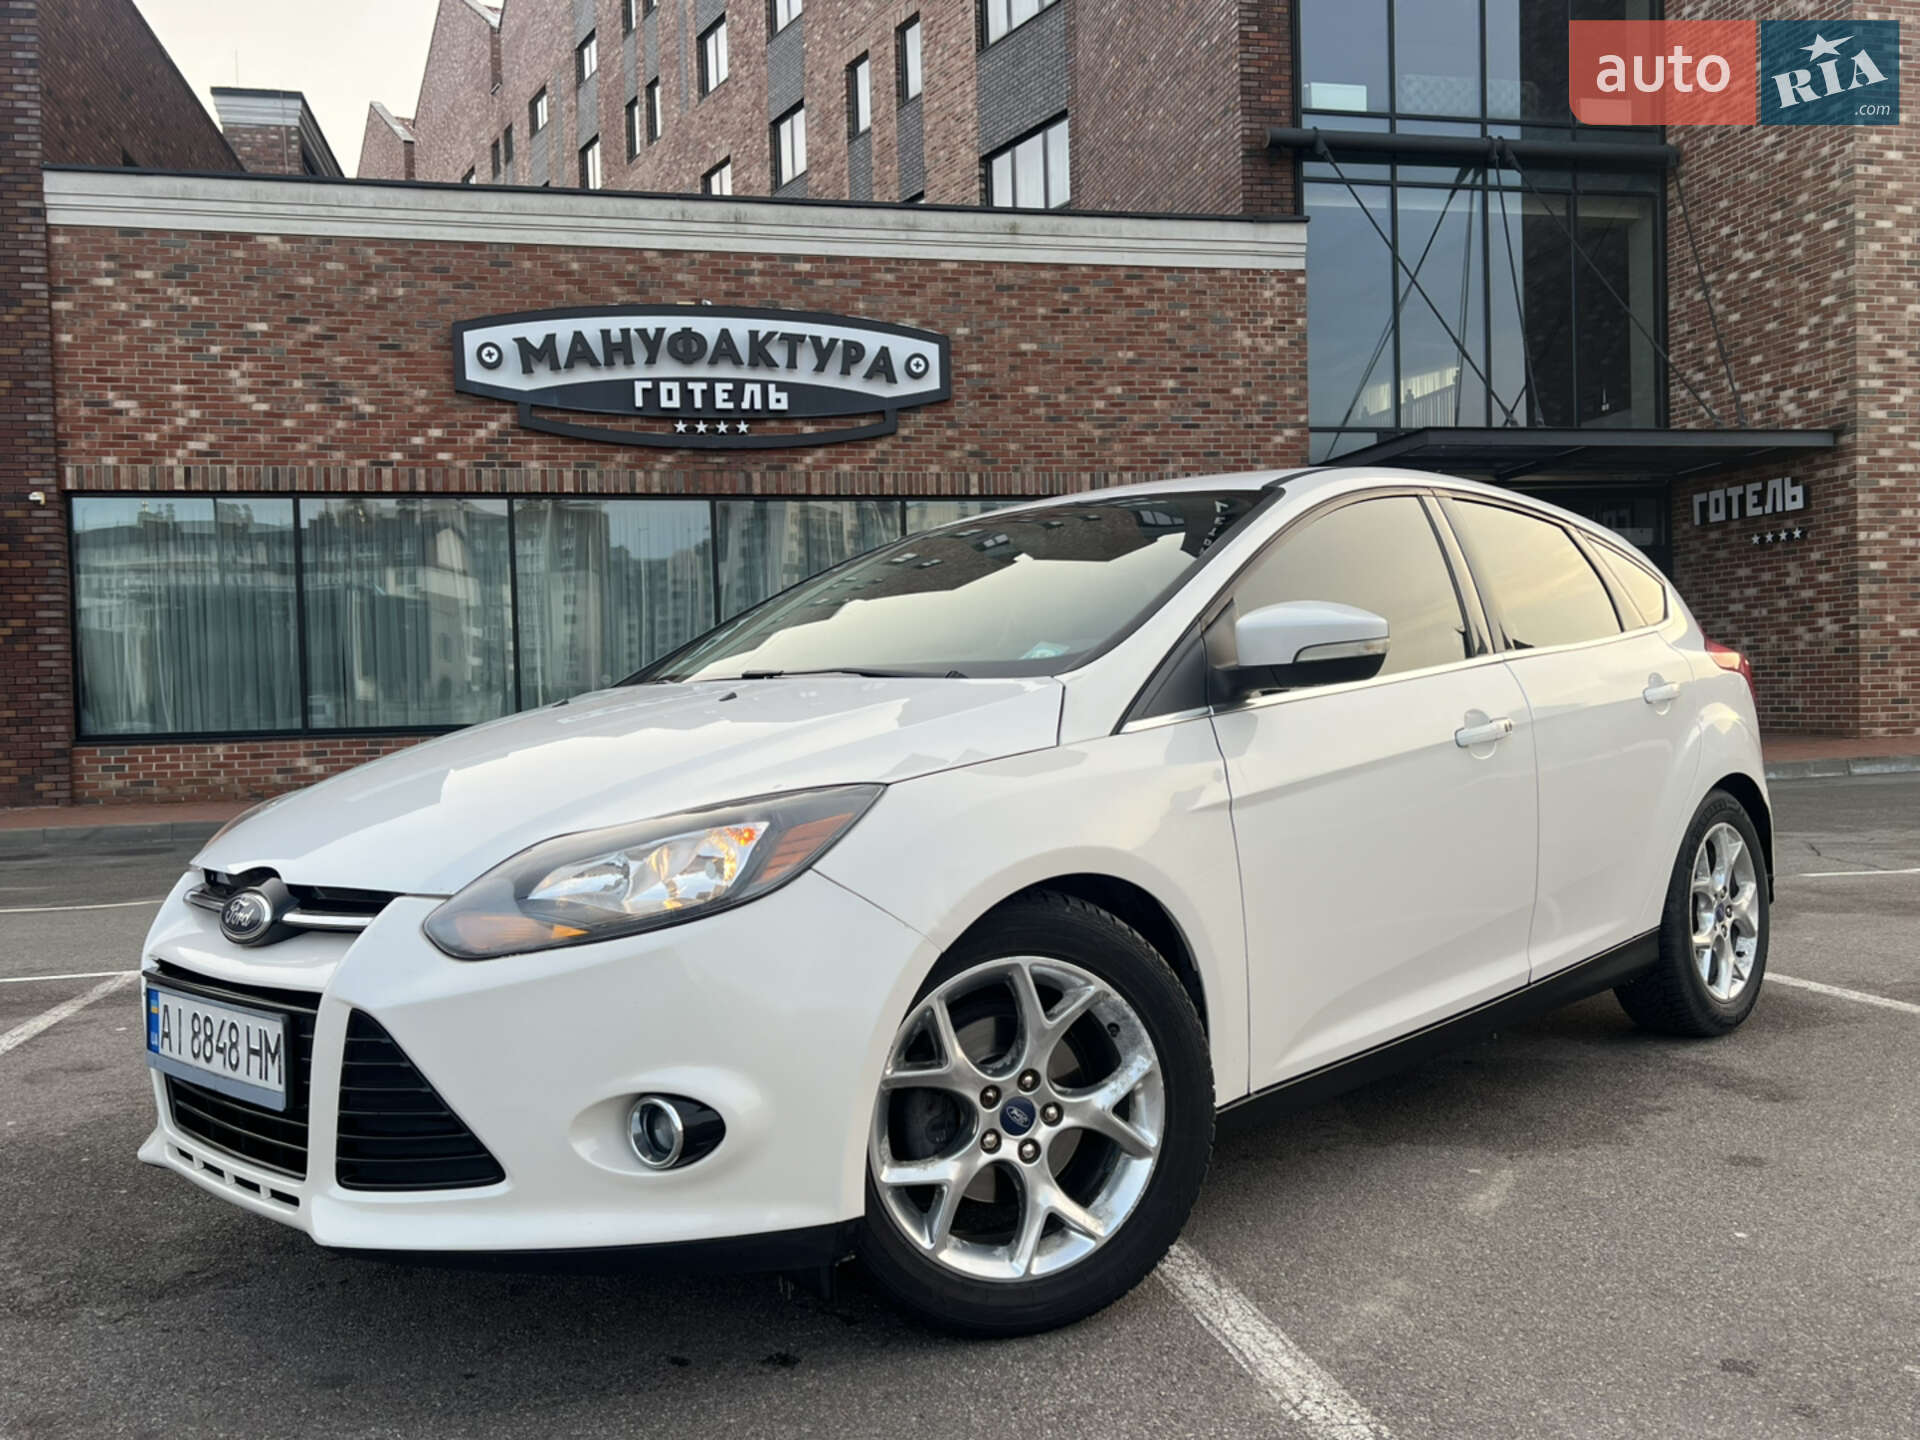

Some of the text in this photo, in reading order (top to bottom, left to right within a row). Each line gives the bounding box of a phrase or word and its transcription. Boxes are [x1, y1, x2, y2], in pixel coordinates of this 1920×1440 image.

[512, 326, 898, 385] МАНУФАКТУРА
[633, 380, 789, 411] ГОТЕЛЬ
[1692, 476, 1805, 526] ГОТЕЛЬ
[225, 898, 255, 928] Ford
[191, 1011, 240, 1072] 8848
[246, 1024, 283, 1086] HM
